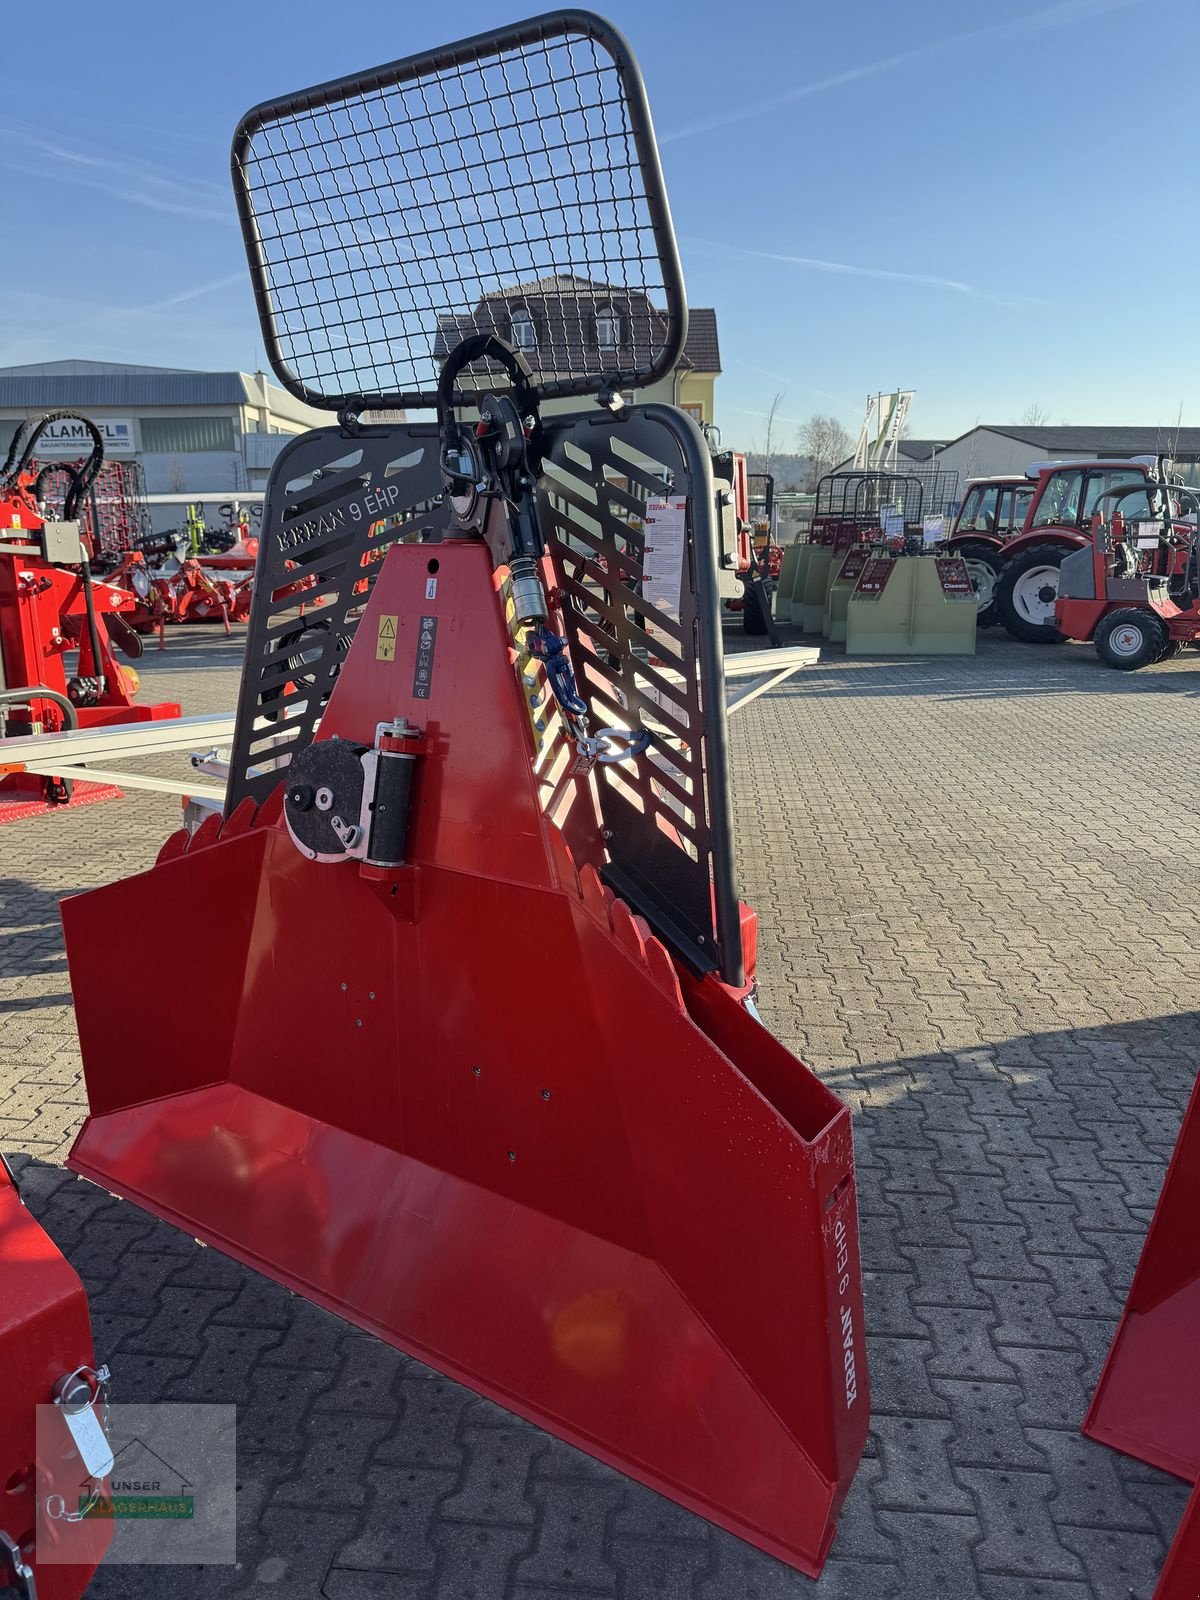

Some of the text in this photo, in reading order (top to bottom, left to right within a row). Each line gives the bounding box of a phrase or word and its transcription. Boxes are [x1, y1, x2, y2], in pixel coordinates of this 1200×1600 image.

[276, 485, 399, 552] KRPAN 9 EHP
[834, 1220, 848, 1273] EHP
[838, 1273, 850, 1295] 9
